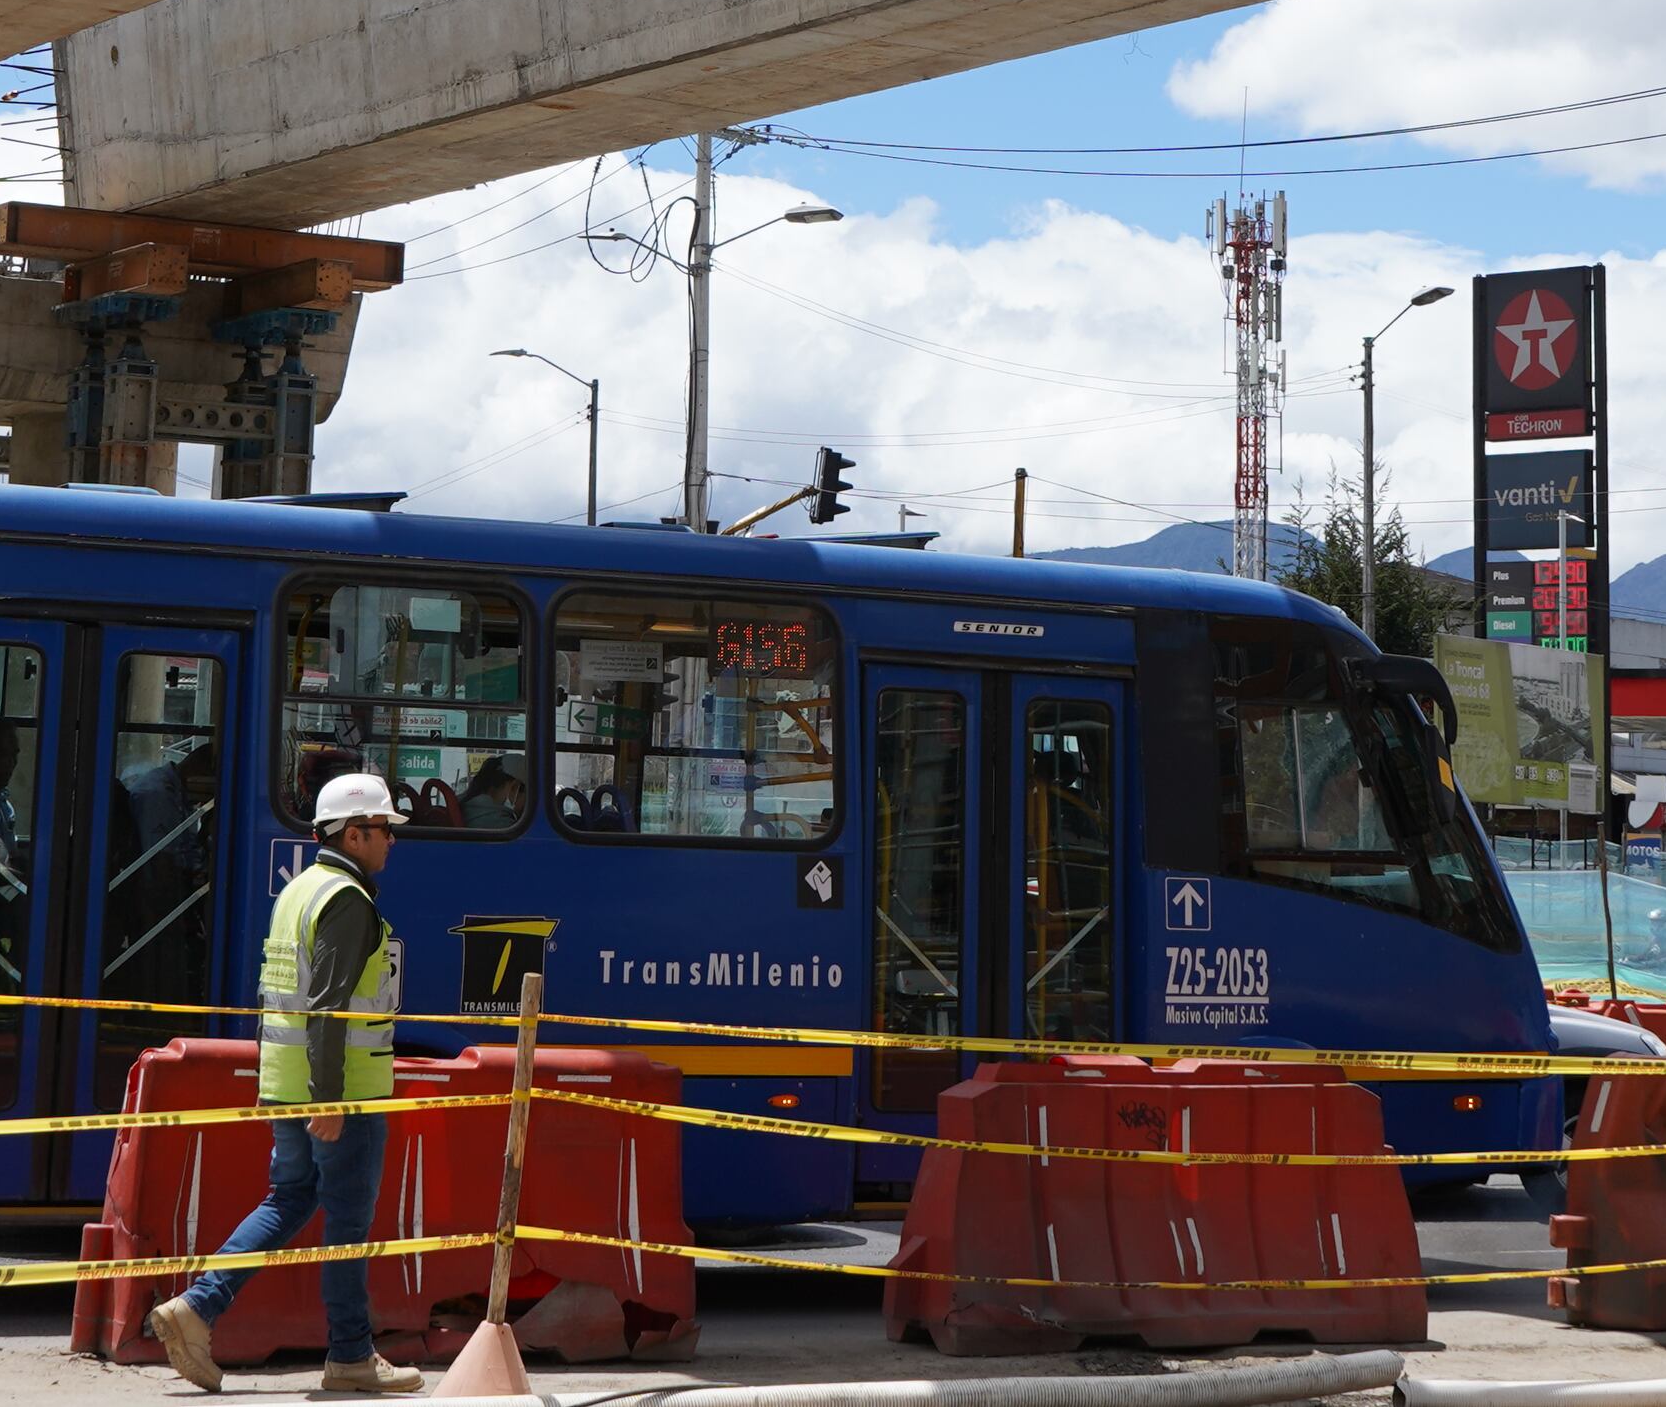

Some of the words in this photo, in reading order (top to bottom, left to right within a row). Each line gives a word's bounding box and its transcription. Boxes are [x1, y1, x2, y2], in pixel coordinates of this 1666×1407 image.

[1507, 419, 1563, 434] TECHRON
[1494, 480, 1555, 507] vanti
[1493, 571, 1509, 581] Plus
[1493, 595, 1526, 606] Premium
[961, 623, 1038, 635] SENIOR
[1493, 620, 1516, 631] Diesel
[1445, 659, 1454, 675] La
[1455, 660, 1485, 679] Troncal
[1479, 682, 1490, 699] 68
[399, 755, 435, 770] Salida
[600, 950, 843, 988] TransMilenio
[1165, 947, 1269, 996] Z25-2053
[463, 1001, 521, 1012] TRANSMILE
[1165, 1004, 1201, 1025] Masivo
[1203, 1005, 1239, 1030] Capital
[1240, 1007, 1269, 1025] S.A.S.
